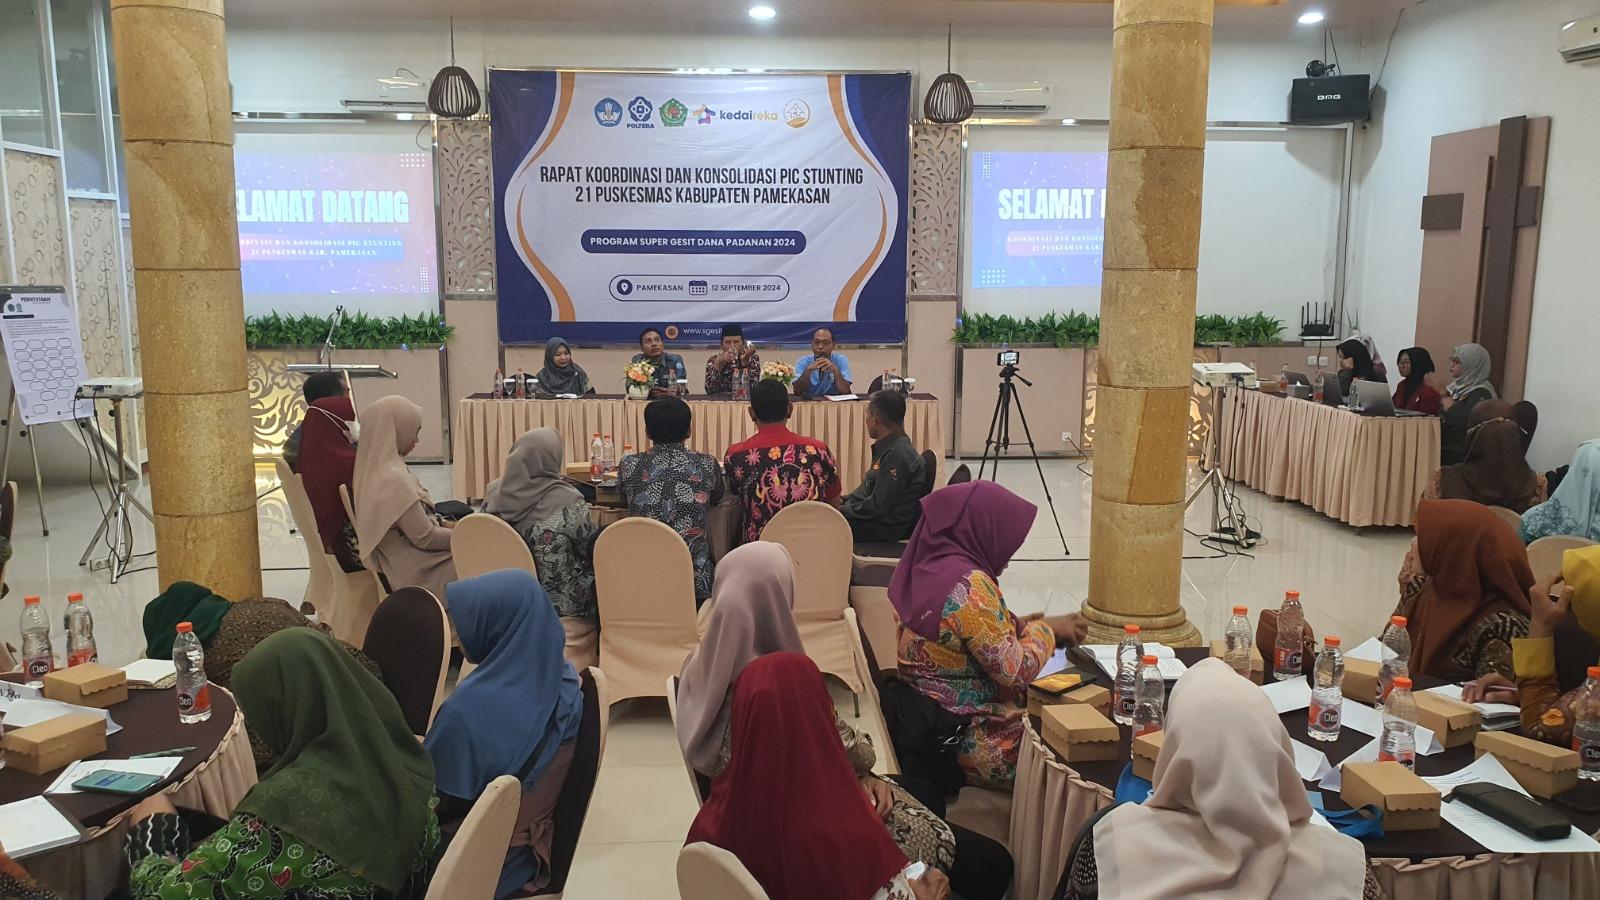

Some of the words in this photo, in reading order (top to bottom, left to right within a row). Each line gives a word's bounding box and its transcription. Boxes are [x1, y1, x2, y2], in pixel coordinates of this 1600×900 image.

[719, 109, 779, 121] kedaireka
[540, 166, 582, 183] RAPAT
[586, 166, 662, 183] KOORDINASI
[665, 167, 692, 183] DAN
[695, 167, 776, 184] KONSOLIDASI
[780, 168, 800, 184] PIC
[803, 168, 863, 184] STUNTING
[575, 186, 591, 202] 21
[595, 186, 672, 203] PUSKESMAS
[675, 187, 750, 203] KABUPATEN
[753, 188, 830, 204] PAMEKASAN
[236, 189, 315, 222] LAMAT
[321, 190, 409, 223] DATANG
[998, 188, 1095, 220] SELAMAT
[590, 237, 638, 246] PROGRAM
[639, 237, 668, 246] SUPER
[670, 238, 695, 246] GESIT
[697, 238, 724, 247] DANA
[726, 238, 772, 247] PADANAN
[773, 238, 795, 247] 2024
[32, 664, 48, 674] Cleo
[1586, 748, 1600, 759] Cle
